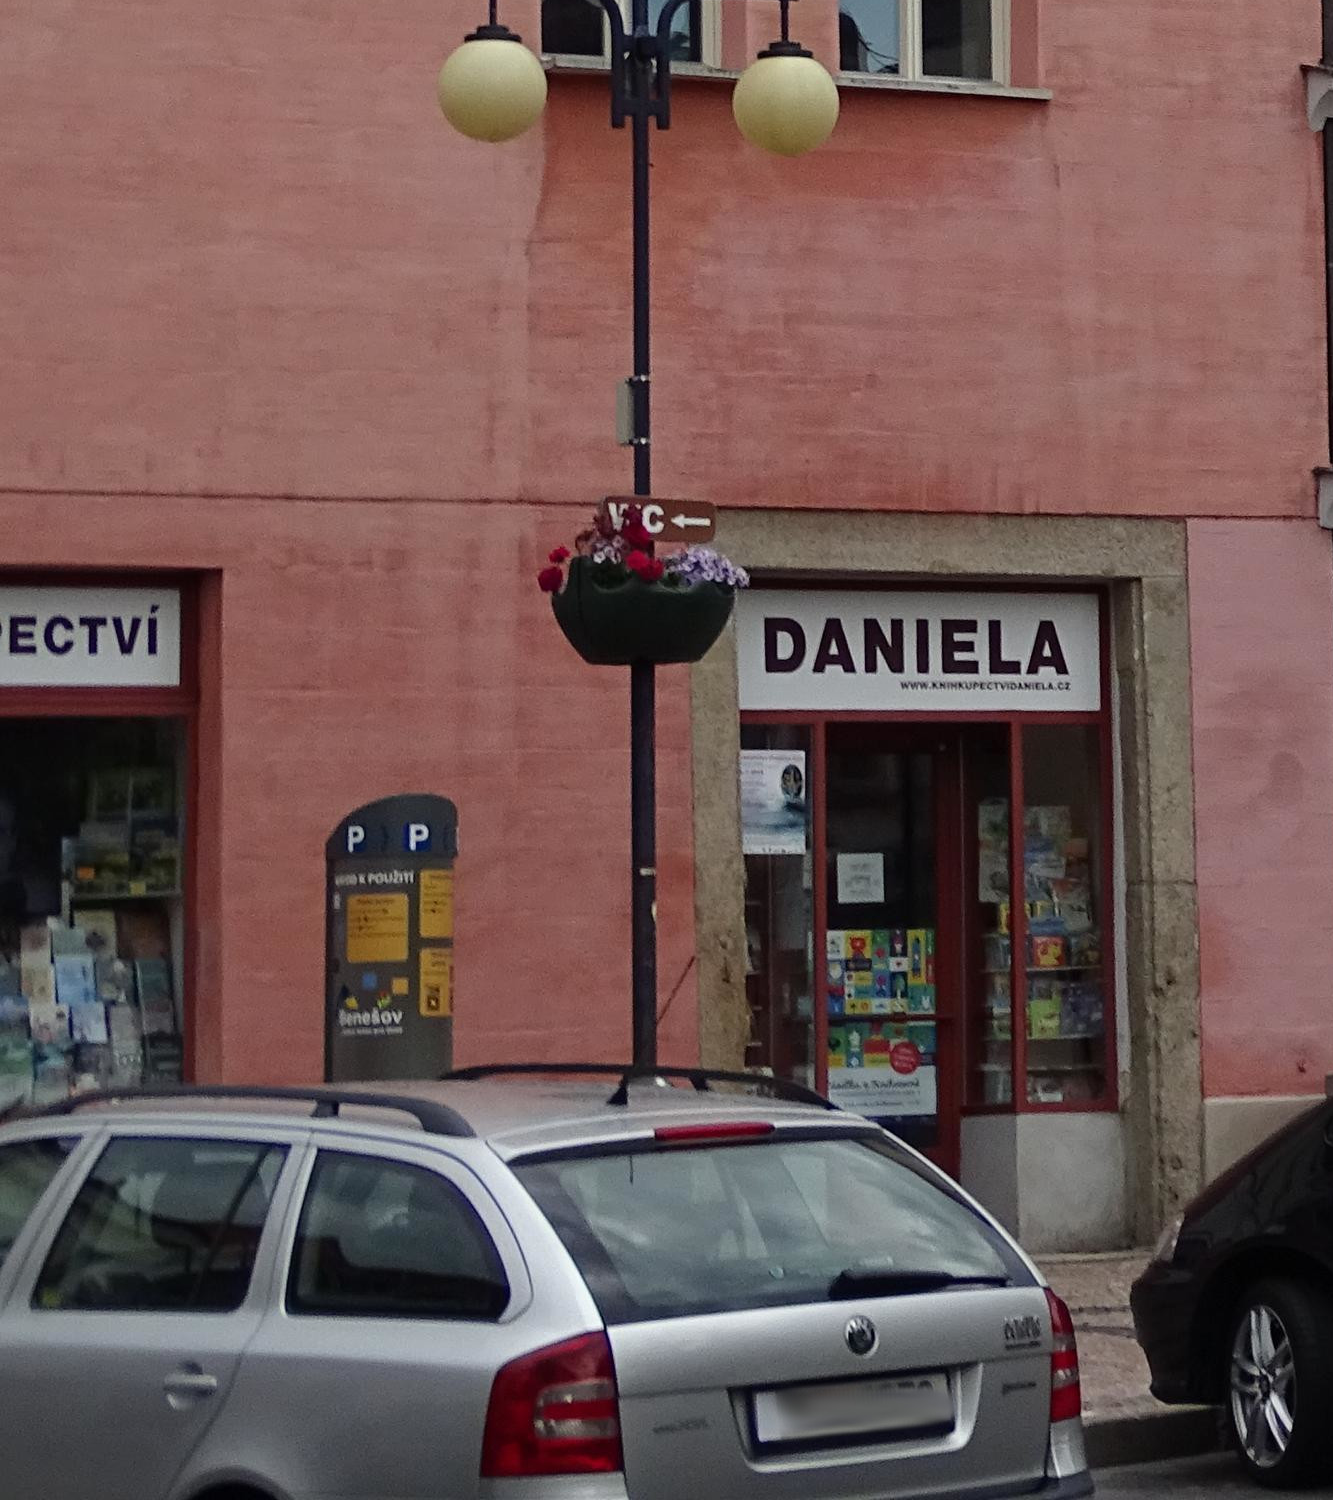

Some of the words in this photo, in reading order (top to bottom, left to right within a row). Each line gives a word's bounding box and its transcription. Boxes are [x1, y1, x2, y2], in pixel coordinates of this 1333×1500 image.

[0, 604, 159, 656] ECTVÍ
[764, 617, 1069, 675] DANIELA
[347, 825, 365, 853] P
[409, 823, 429, 851] P
